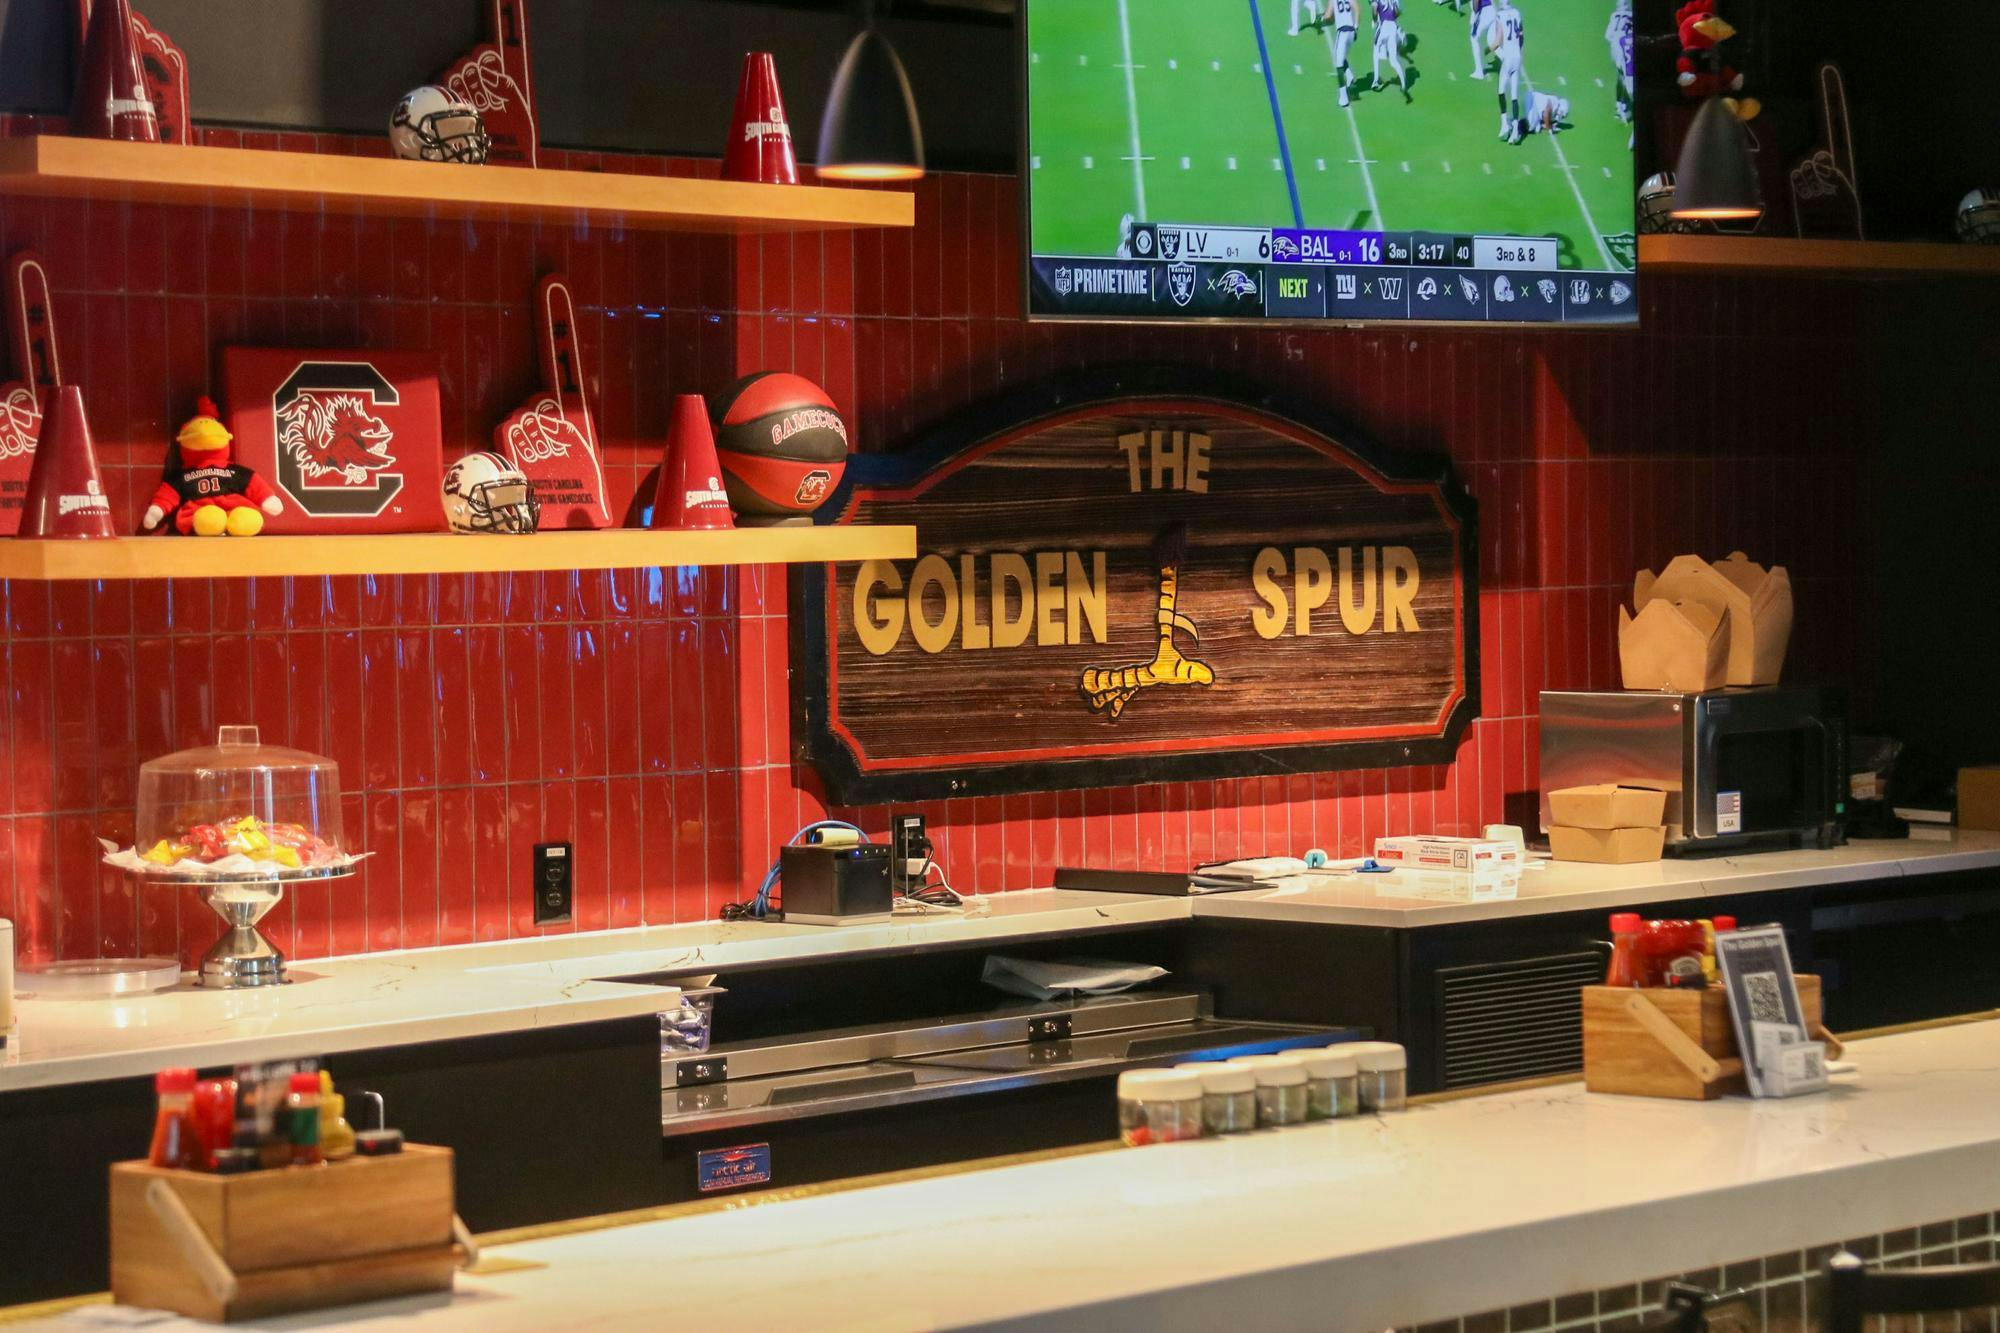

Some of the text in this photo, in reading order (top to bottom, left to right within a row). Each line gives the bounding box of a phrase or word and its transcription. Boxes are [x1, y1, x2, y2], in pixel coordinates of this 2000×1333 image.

[1186, 232, 1207, 253] LV
[1258, 235, 1270, 258] 6
[1301, 235, 1333, 257] BAL
[1358, 238, 1380, 262] 16
[1388, 243, 1407, 259] 3RD
[1418, 244, 1445, 260] 3:17
[1456, 246, 1469, 260] 40
[1496, 246, 1536, 262] 3RD & 8
[1073, 268, 1148, 295] PRIMETIME
[1279, 278, 1308, 298] NEXT
[1119, 430, 1212, 494] THE
[198, 478, 220, 493] 01
[852, 546, 1420, 656] GOLDEN SPUR
[1723, 819, 1734, 827] USA
